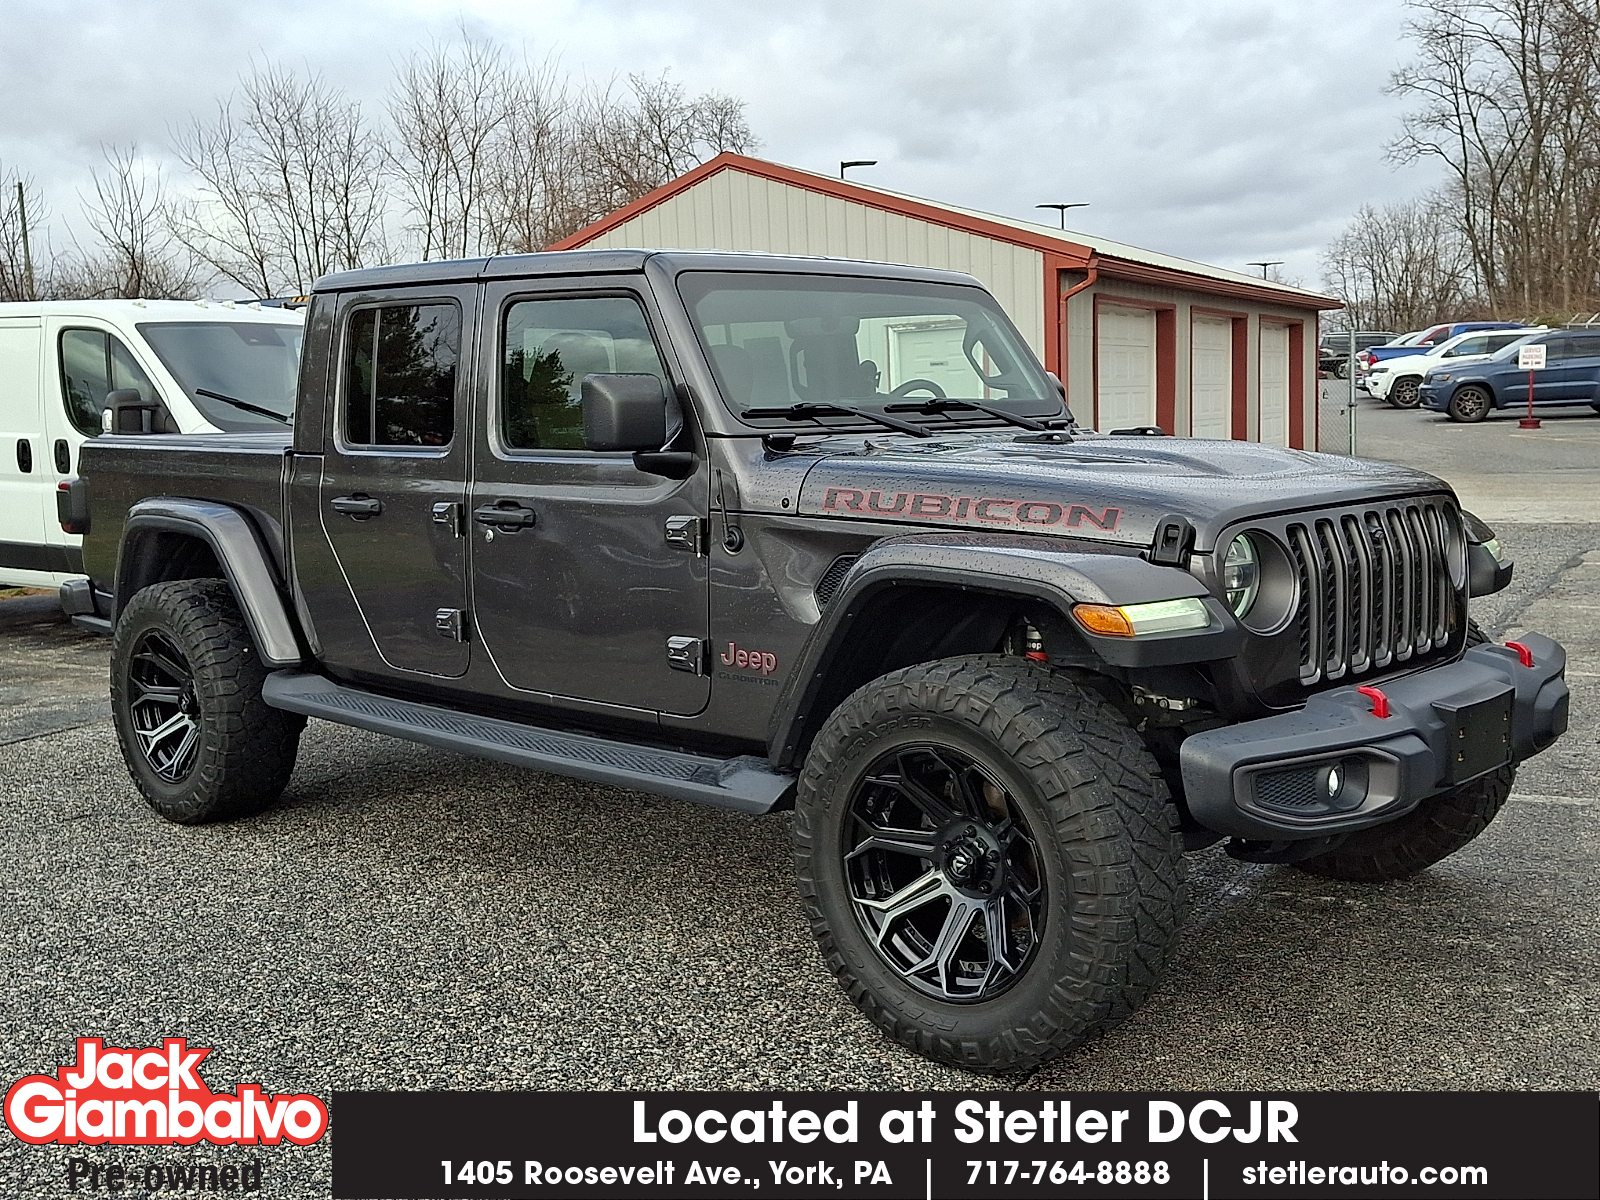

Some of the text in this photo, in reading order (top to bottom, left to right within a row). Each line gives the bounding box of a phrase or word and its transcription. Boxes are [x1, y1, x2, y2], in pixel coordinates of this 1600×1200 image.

[822, 487, 1122, 532] RUBICON
[720, 642, 777, 676] Jeep
[718, 671, 779, 686] GLADIATOR
